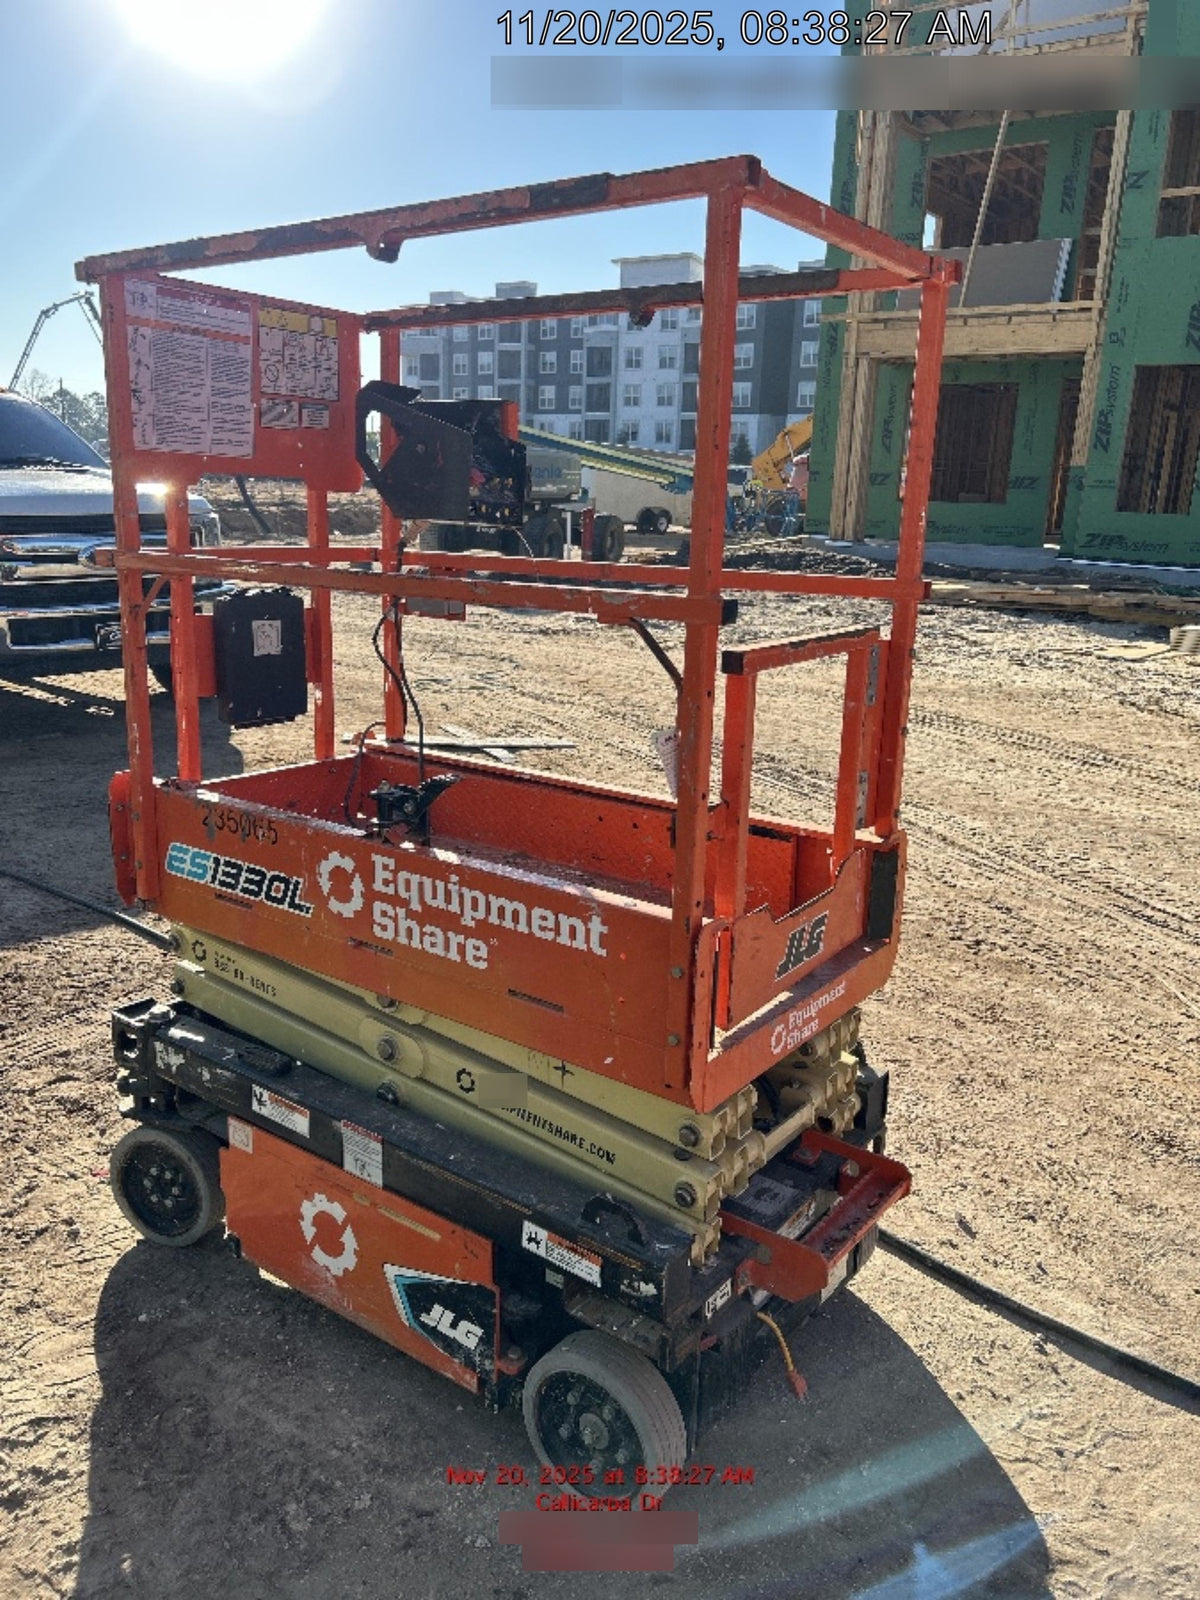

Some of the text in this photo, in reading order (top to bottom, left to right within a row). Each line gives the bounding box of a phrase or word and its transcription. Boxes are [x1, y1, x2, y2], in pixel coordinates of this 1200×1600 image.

[165, 842, 315, 918] ES1330L
[371, 853, 608, 957] Equipment
[372, 901, 488, 970] Share
[774, 910, 830, 982] JLG
[786, 1018, 820, 1051] Share
[788, 979, 847, 1031] Equipment
[420, 1303, 485, 1351] JLG
